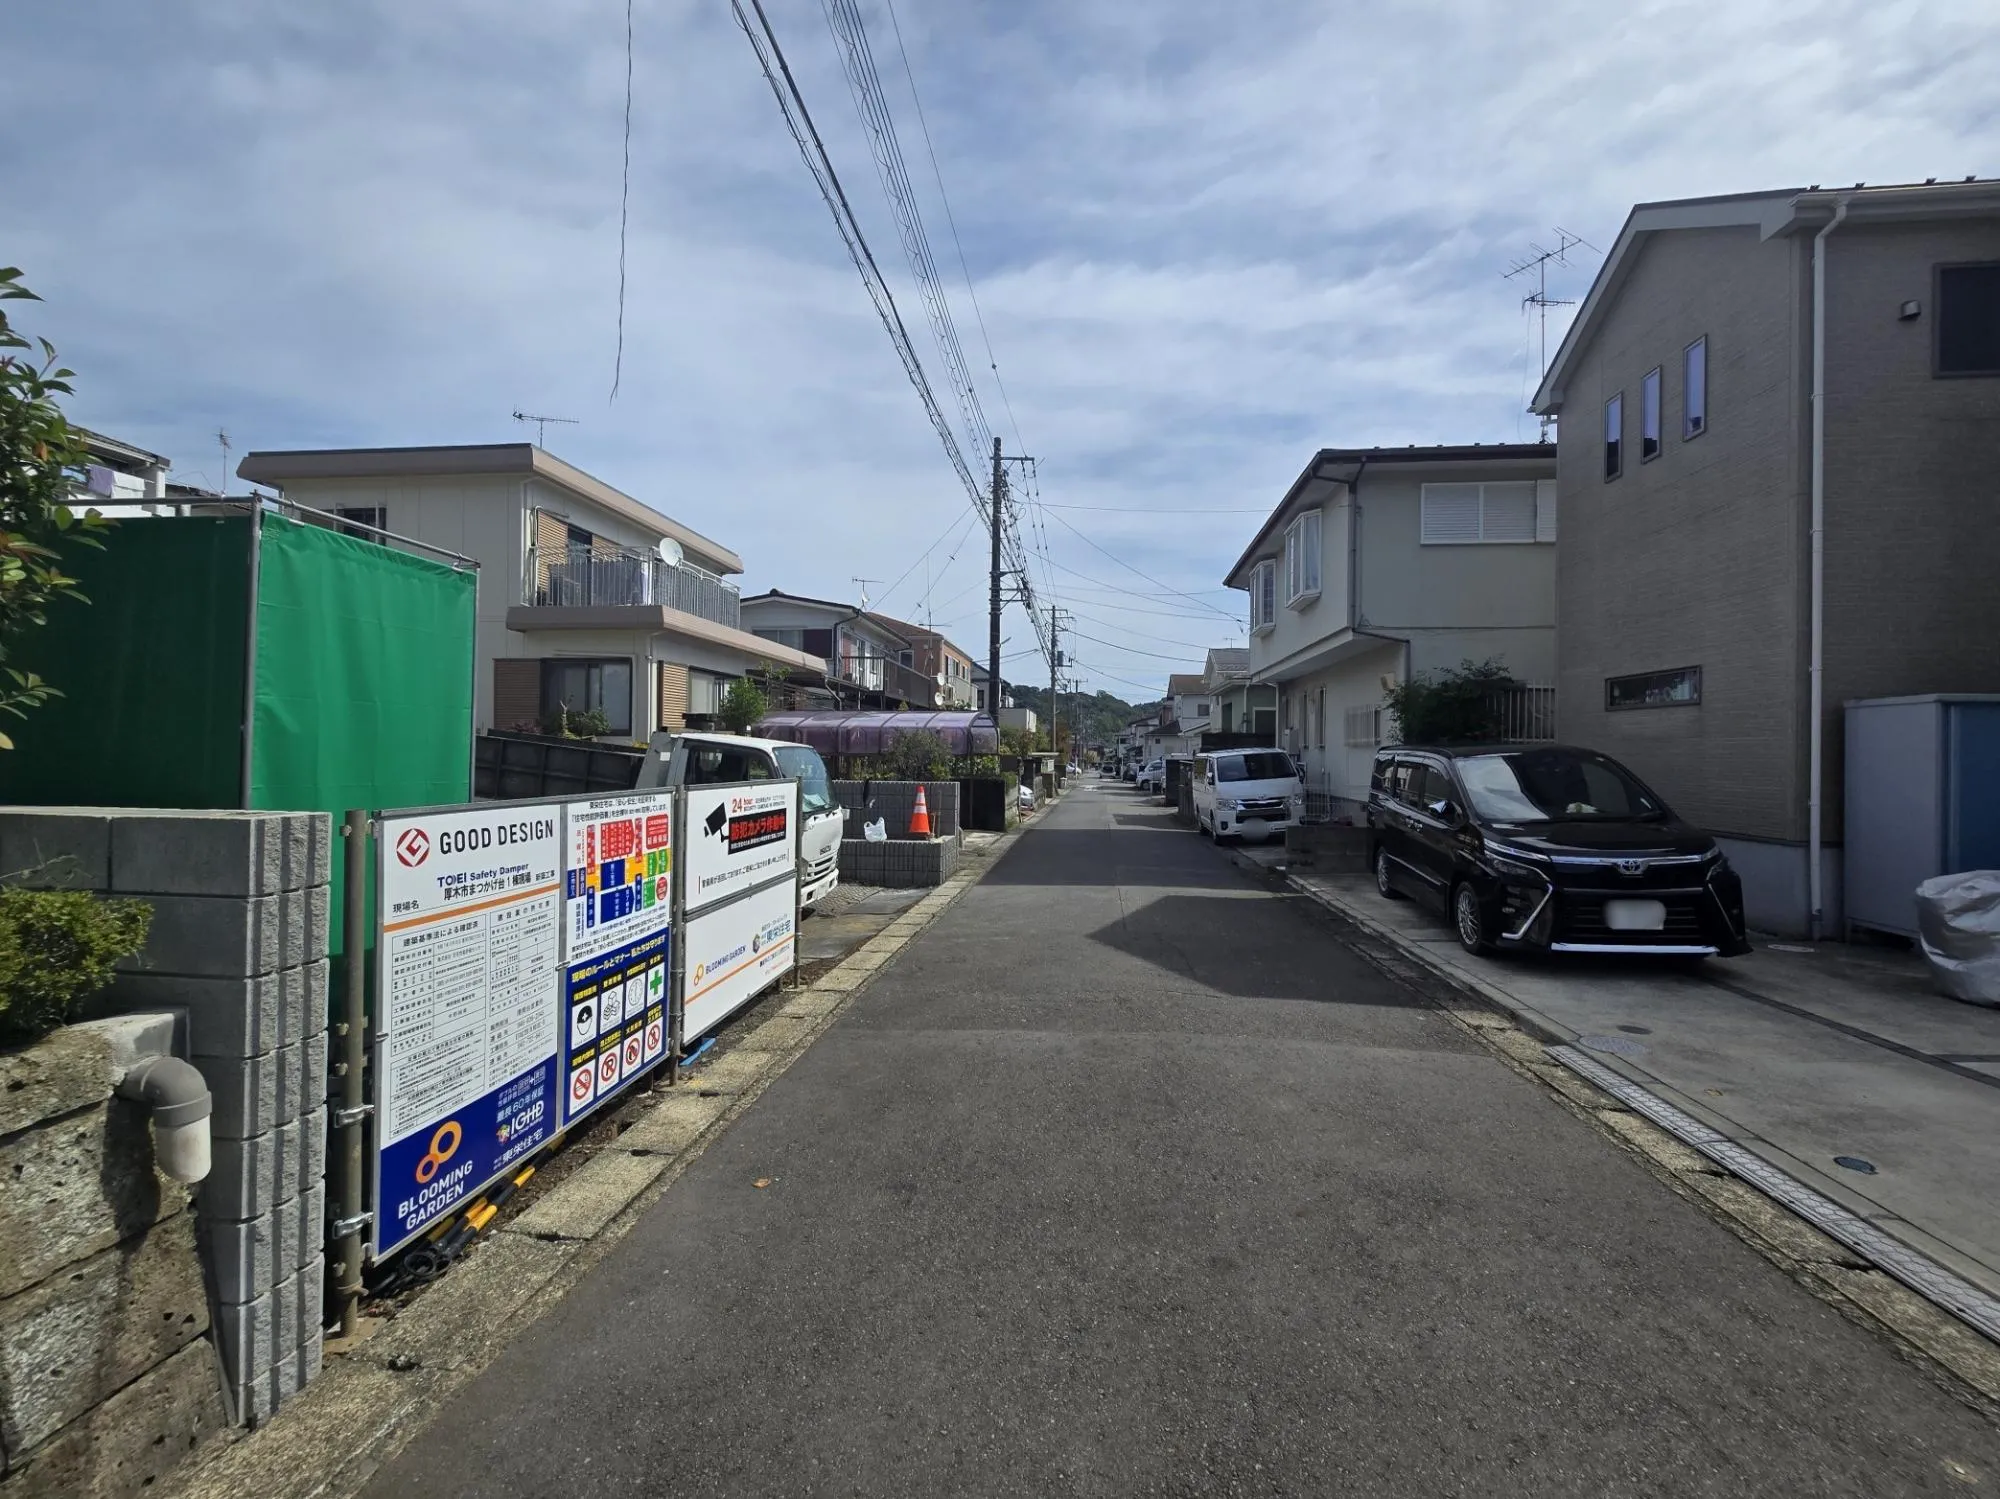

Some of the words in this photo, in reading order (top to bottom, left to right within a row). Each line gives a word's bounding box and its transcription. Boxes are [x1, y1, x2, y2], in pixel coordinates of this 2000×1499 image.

[439, 828, 491, 855] GOOD
[498, 819, 553, 846] DESIGN
[470, 867, 497, 882] Safety
[499, 863, 529, 876] Damper
[392, 900, 419, 913] 現場名
[398, 1160, 473, 1219] BLOOMING
[406, 1181, 464, 1230] GARDEN
